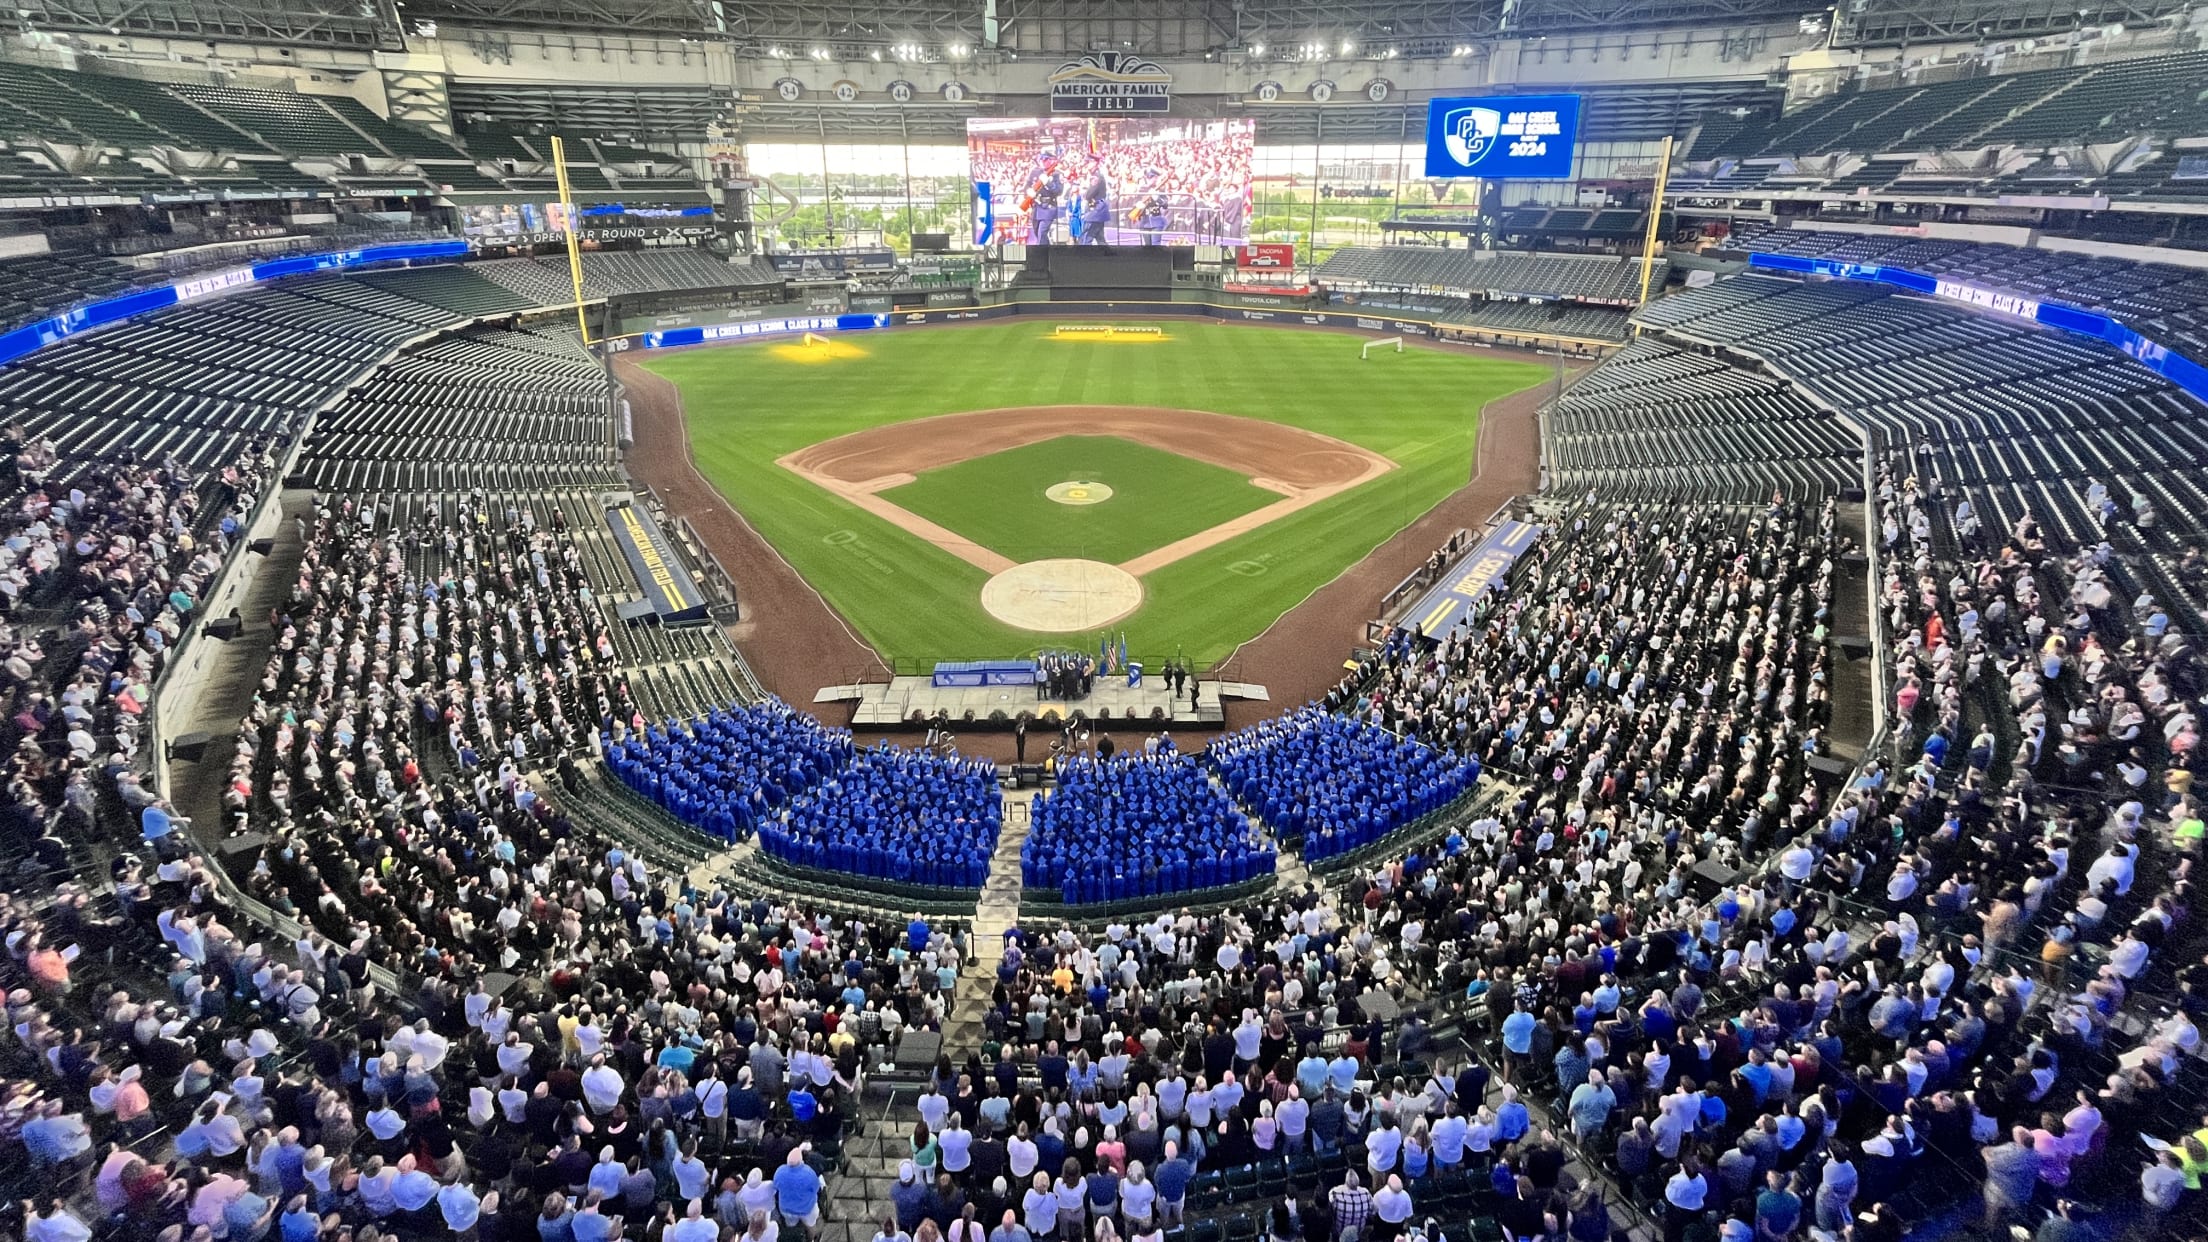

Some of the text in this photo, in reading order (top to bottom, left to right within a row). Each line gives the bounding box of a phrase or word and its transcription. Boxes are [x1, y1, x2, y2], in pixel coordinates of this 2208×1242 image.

[783, 86, 797, 97] 34
[839, 87, 853, 98] 42
[895, 87, 908, 98] 44
[1053, 85, 1168, 95] AMERICAN FAMILY
[1263, 89, 1275, 99] 19
[1087, 98, 1134, 109] FIELD
[1509, 142, 1546, 156] 2024
[534, 232, 563, 243] OPEN
[602, 228, 646, 239] ROUND
[1241, 297, 1281, 305] TOYOTA.COM
[703, 318, 838, 339] OAK CREEK HIGH SCHOOL CLASS OF 2024
[1453, 557, 1504, 596] BREWERS
